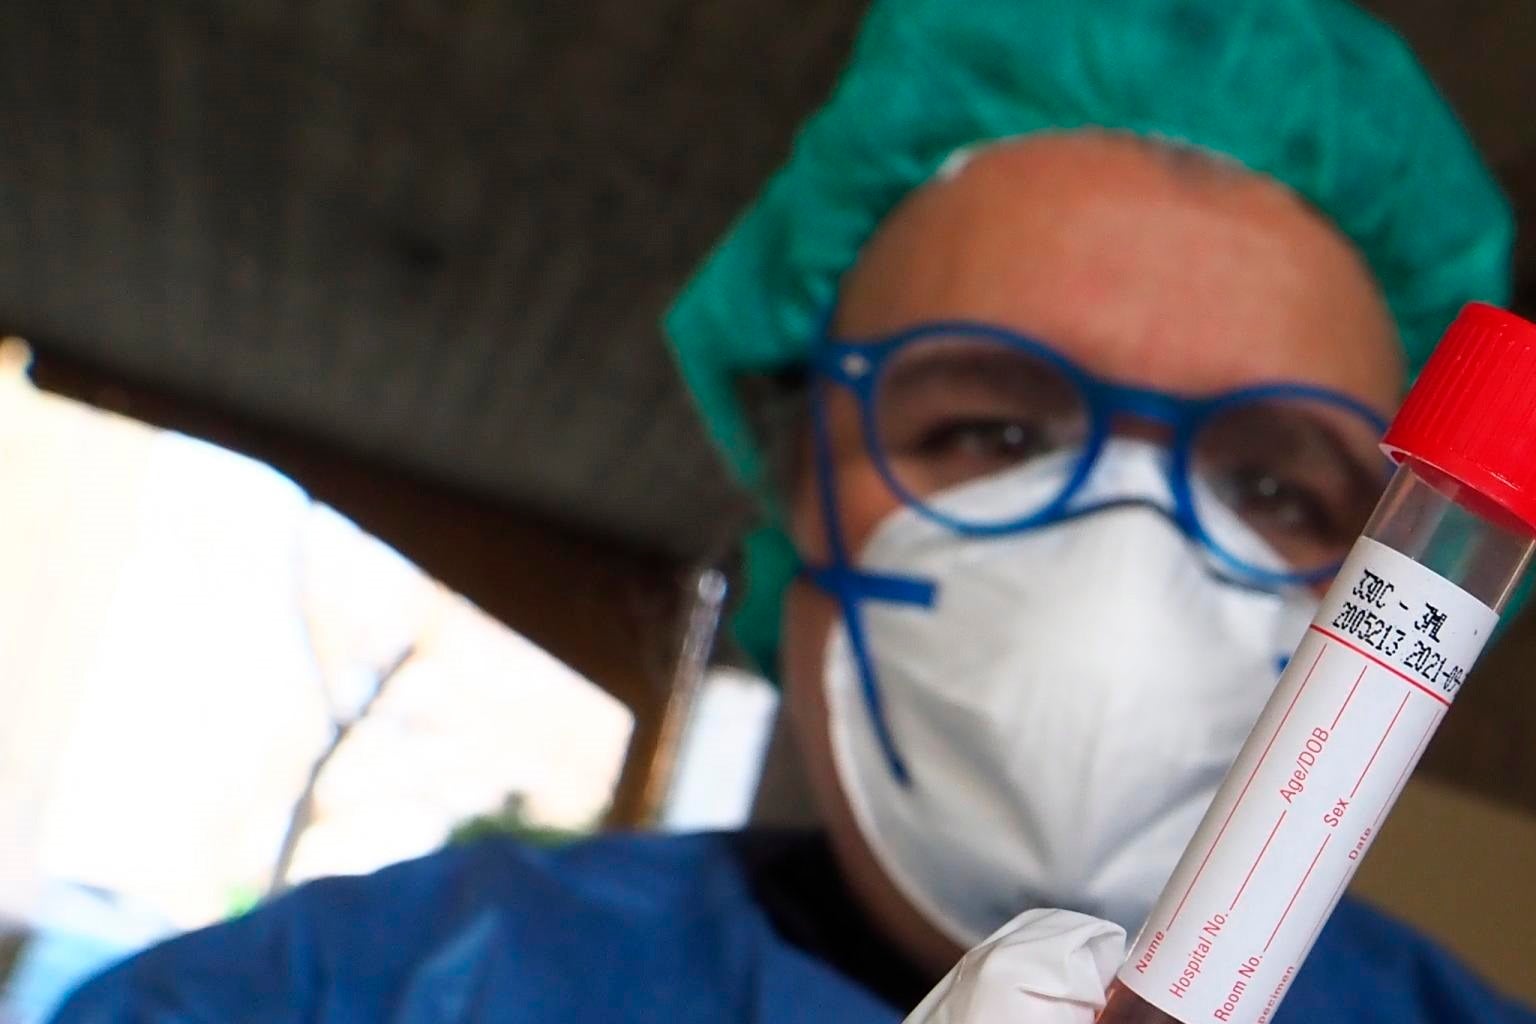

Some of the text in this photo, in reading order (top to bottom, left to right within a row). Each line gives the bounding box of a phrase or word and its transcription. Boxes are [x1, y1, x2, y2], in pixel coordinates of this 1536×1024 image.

[1332, 602, 1406, 656] 2005213
[1280, 727, 1329, 803] Age/DOB
[1323, 798, 1349, 827] Sex
[1348, 827, 1372, 860] Date
[1136, 931, 1165, 973] Name
[1169, 913, 1229, 998] Hospital No.
[1214, 955, 1263, 1022] Room No.
